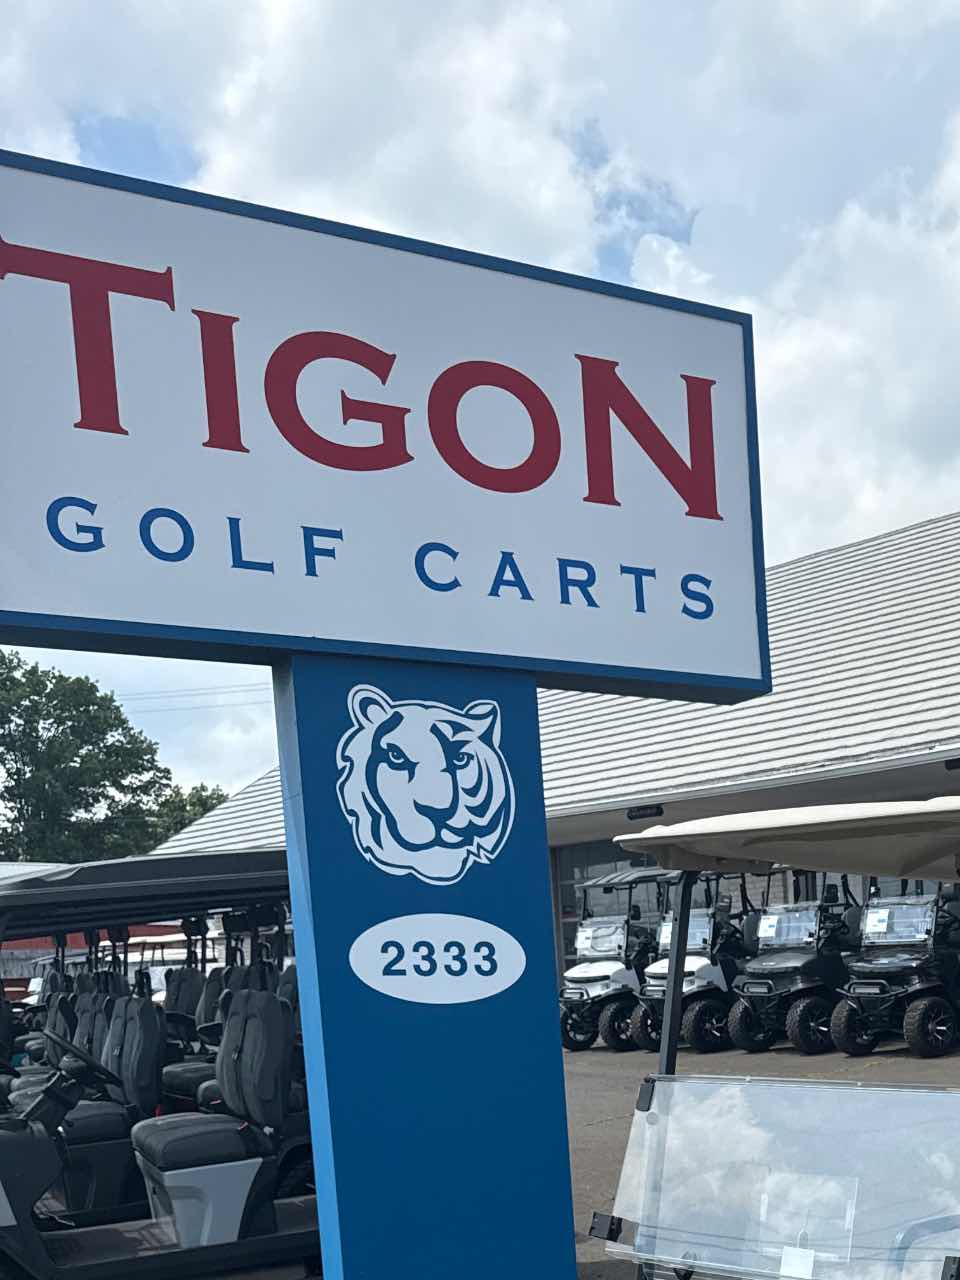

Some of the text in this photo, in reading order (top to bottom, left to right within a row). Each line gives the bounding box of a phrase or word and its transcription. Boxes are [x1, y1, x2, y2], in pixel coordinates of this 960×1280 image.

[0, 238, 723, 521] TIGON
[44, 495, 716, 621] GOLF CARTS
[380, 940, 499, 977] 2333
